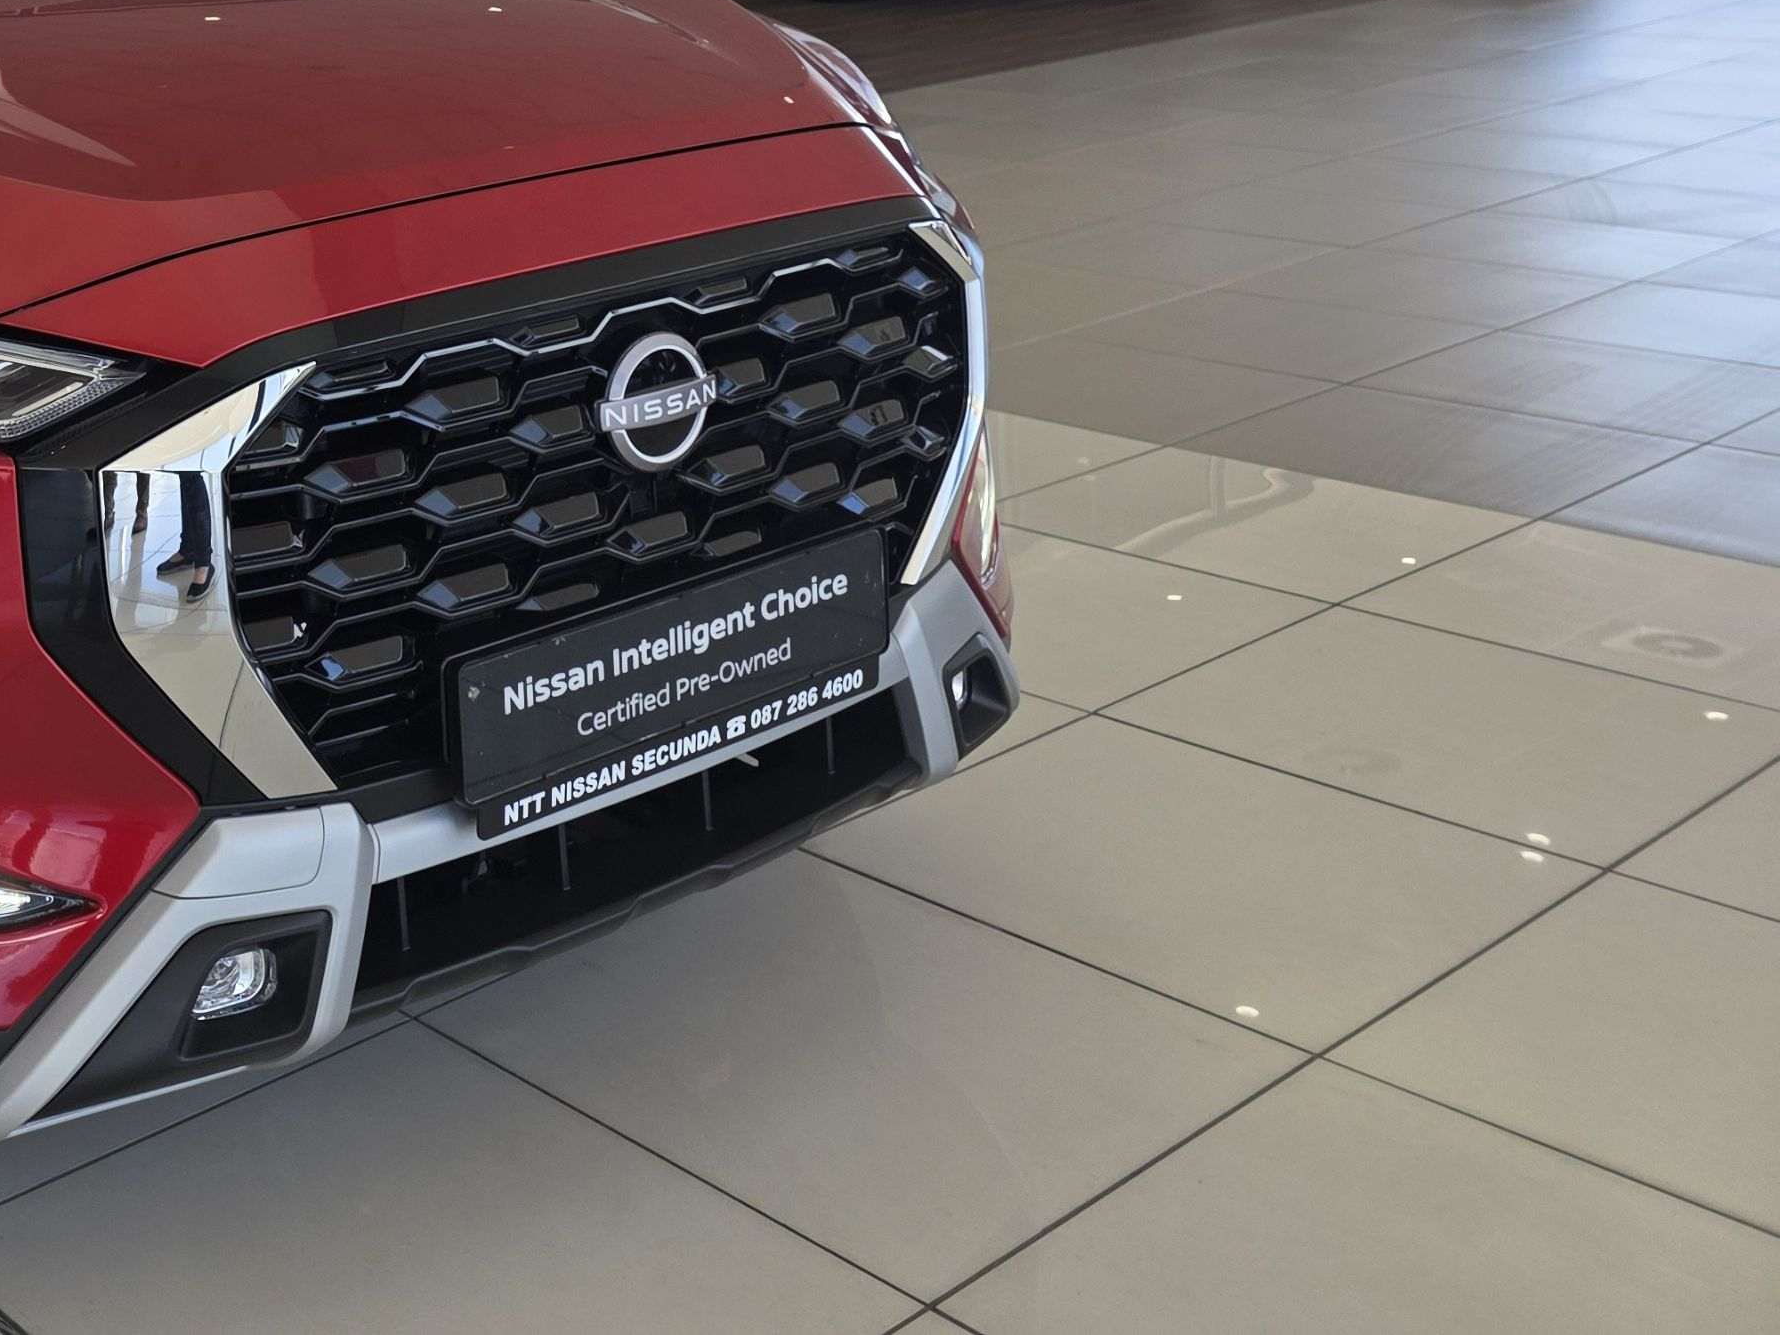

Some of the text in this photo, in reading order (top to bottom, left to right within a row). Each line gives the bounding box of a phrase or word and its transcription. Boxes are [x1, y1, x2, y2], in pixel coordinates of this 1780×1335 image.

[605, 379, 717, 427] NISSAN
[503, 573, 848, 715] Nissan Intelligent Choice
[576, 637, 792, 736] Certified Pre-Owned
[504, 668, 864, 826] NTT NISSAN SECUNDA 087 286 4600
